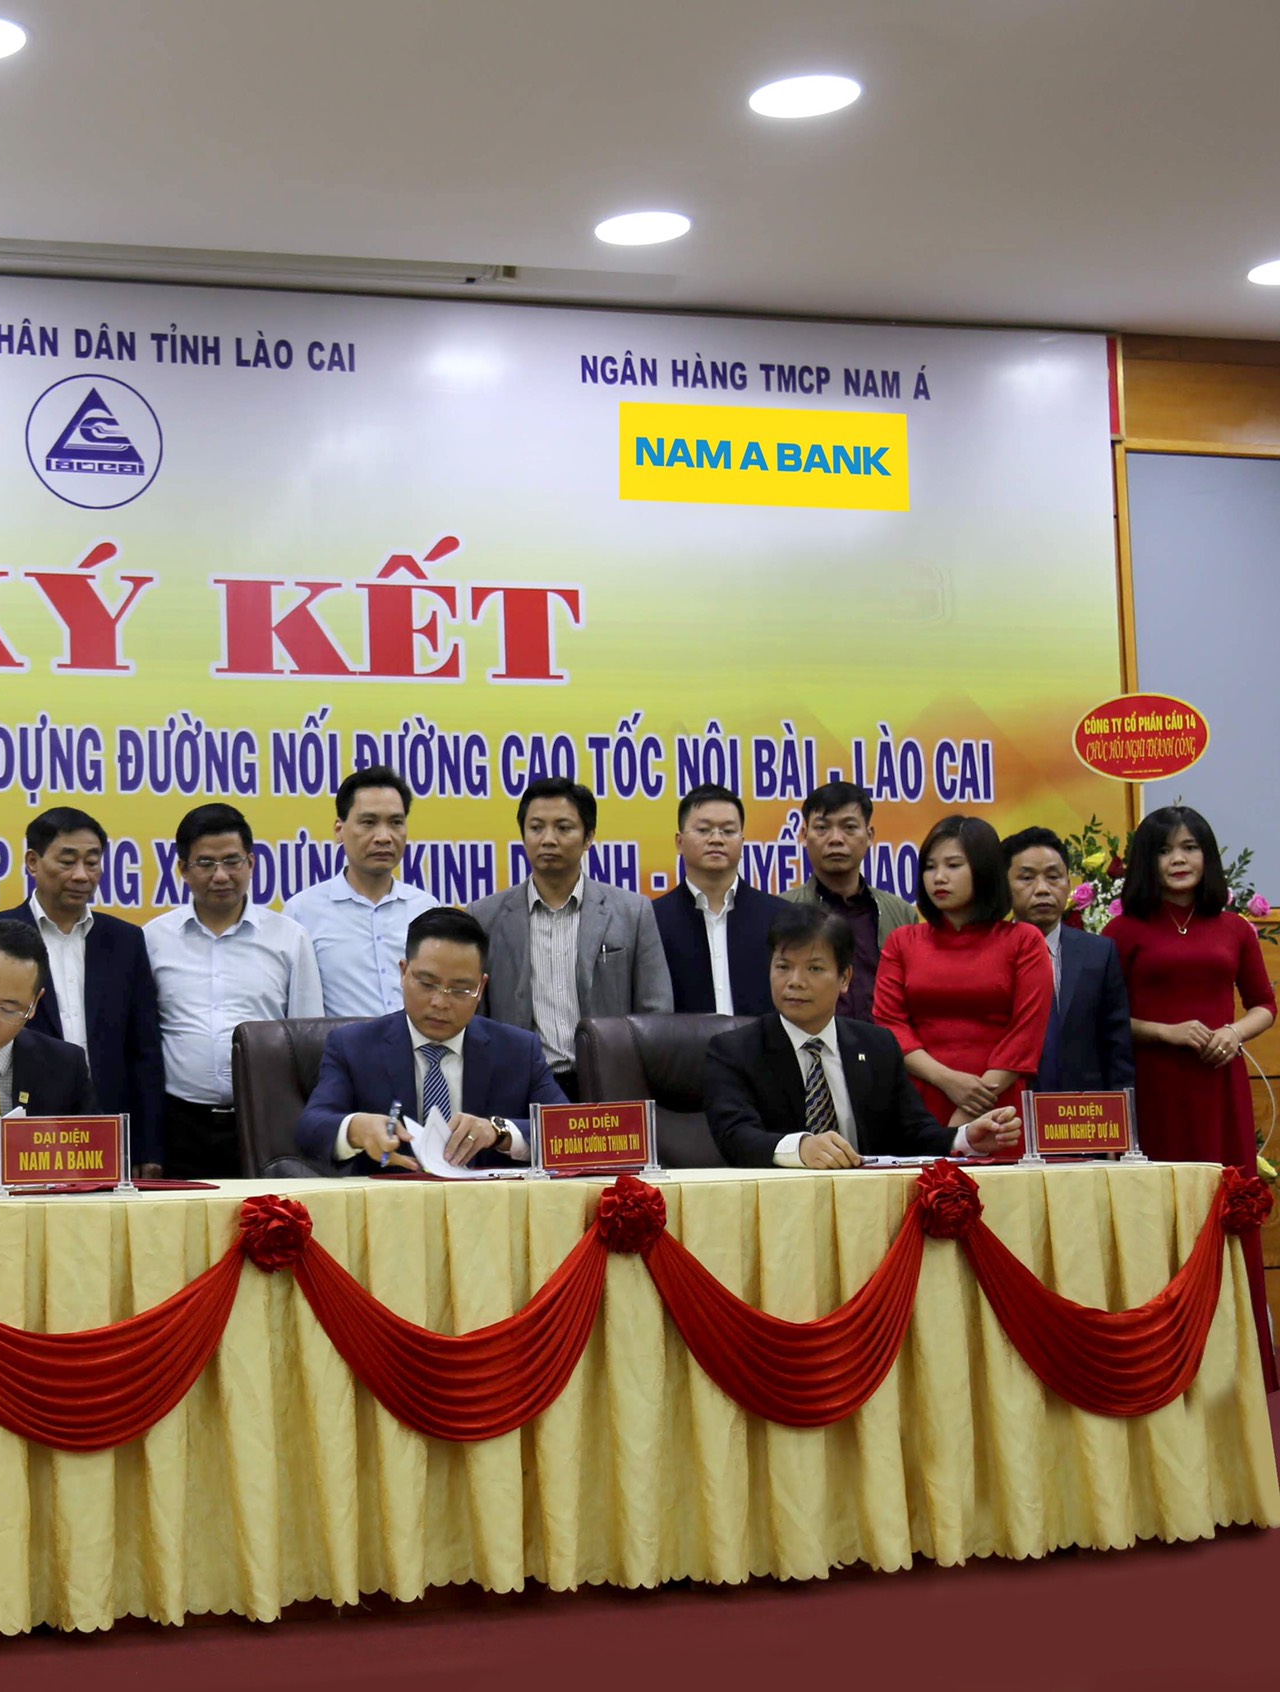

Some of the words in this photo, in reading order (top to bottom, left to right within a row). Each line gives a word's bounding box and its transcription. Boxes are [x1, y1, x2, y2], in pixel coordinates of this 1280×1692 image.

[75, 323, 136, 362] DÂN
[151, 324, 221, 367] TỈNH
[236, 331, 294, 371] LÀO
[308, 342, 356, 373] CAI
[581, 351, 658, 386] NGÂN
[671, 353, 748, 391] HÀNG
[760, 363, 831, 395] TMCP
[844, 368, 901, 399] NAM
[913, 365, 931, 401] Á
[636, 437, 731, 469] NAM
[740, 442, 768, 471] A
[777, 443, 891, 476] BANK
[213, 536, 579, 680] KẾT
[1084, 716, 1109, 734] CÔNG
[1111, 718, 1122, 732] TY
[1124, 712, 1137, 732] CỔ
[1139, 711, 1163, 731] PHẦN
[1165, 710, 1183, 730] CẦU
[1185, 714, 1196, 729] 14
[118, 714, 257, 793] ĐƯỜNG
[274, 708, 339, 795] NỐI
[354, 718, 488, 796] ĐƯỜNG
[502, 735, 575, 796] CAO
[589, 713, 663, 797] TỐC
[754, 723, 814, 797] BÀI
[854, 725, 923, 799] LÀO
[935, 741, 991, 801] CAI
[404, 843, 494, 903] KINH
[1058, 1105, 1076, 1119] ĐẠI
[1080, 1102, 1103, 1119] DIỆN
[568, 1118, 589, 1133] ĐẠI
[593, 1113, 619, 1131] DIỆN
[1045, 1124, 1069, 1139] DOANH
[1071, 1120, 1096, 1142] NGHIỆP
[1098, 1122, 1108, 1141] DỰ
[1109, 1120, 1119, 1138] ÁN
[33, 1132, 56, 1148] ĐẠI
[60, 1128, 90, 1147] DIỆN
[550, 1136, 563, 1158] TẬP
[564, 1135, 583, 1154] ĐOÀN
[608, 1135, 628, 1154] THỊNH
[629, 1134, 640, 1150] THI
[20, 1152, 50, 1171] NAM
[54, 1152, 63, 1170] A
[67, 1150, 104, 1170] BANK
